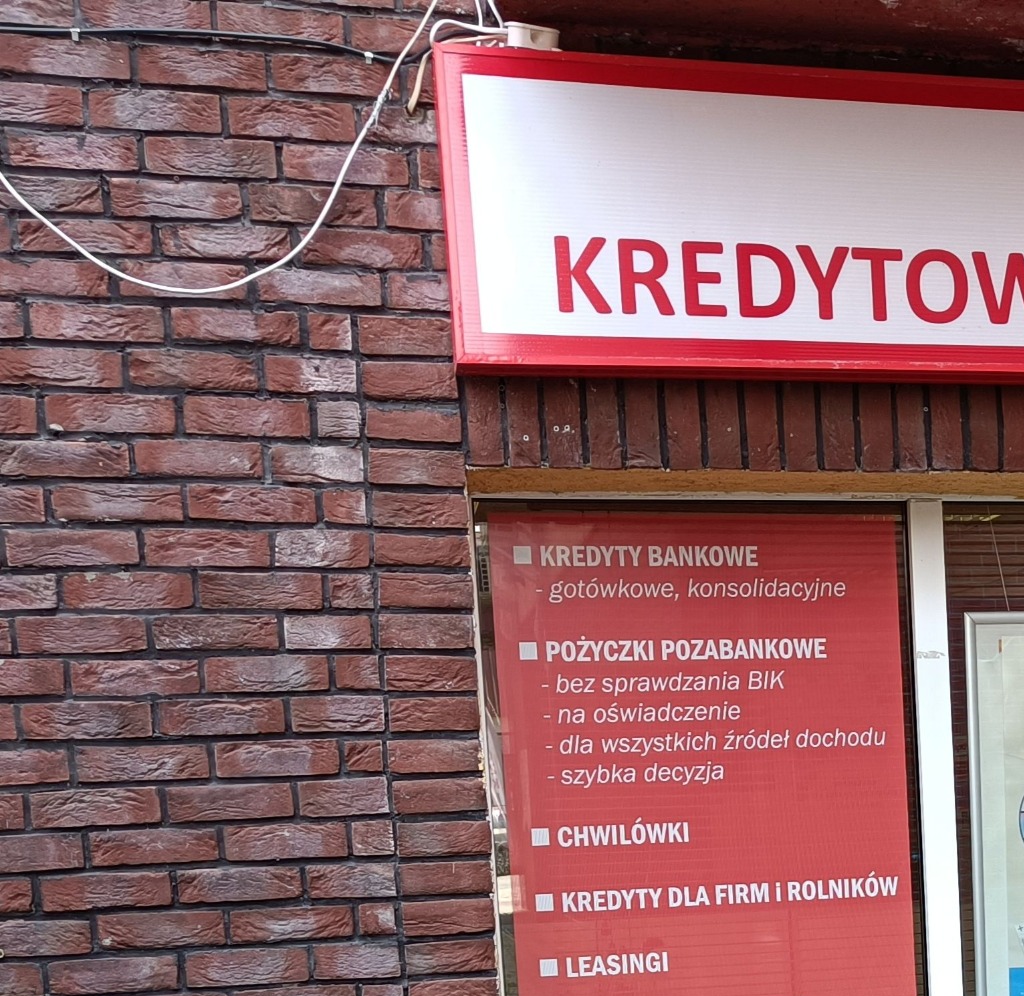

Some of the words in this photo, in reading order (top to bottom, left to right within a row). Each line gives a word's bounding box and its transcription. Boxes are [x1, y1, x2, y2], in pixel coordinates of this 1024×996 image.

[540, 546, 641, 567] KREDYTY
[648, 545, 758, 567] BANKOWE
[549, 577, 679, 603] gotówkowe,
[688, 578, 846, 602] konsolidacyjne
[546, 636, 654, 662] POŻYCZKI
[661, 638, 827, 661] POZABANKOWE
[556, 674, 595, 694] bez
[602, 671, 740, 696] sprawdzania
[748, 670, 785, 690] BIK
[558, 707, 585, 724] na
[594, 701, 740, 724] oświadczenie
[559, 734, 593, 755] dla
[601, 730, 717, 756] wszystkich
[724, 728, 789, 752] źródeł
[796, 726, 886, 749] dochodu
[561, 764, 636, 788] szybka
[644, 761, 725, 785] decyzja
[557, 818, 689, 848] CHWILÓWKI
[562, 888, 662, 913] KREDYTY
[668, 886, 710, 907] DLA
[715, 883, 770, 905] FIRM
[775, 881, 782, 902] i
[788, 871, 898, 900] ROLNIKÓW
[566, 952, 669, 978] LEASINGI
